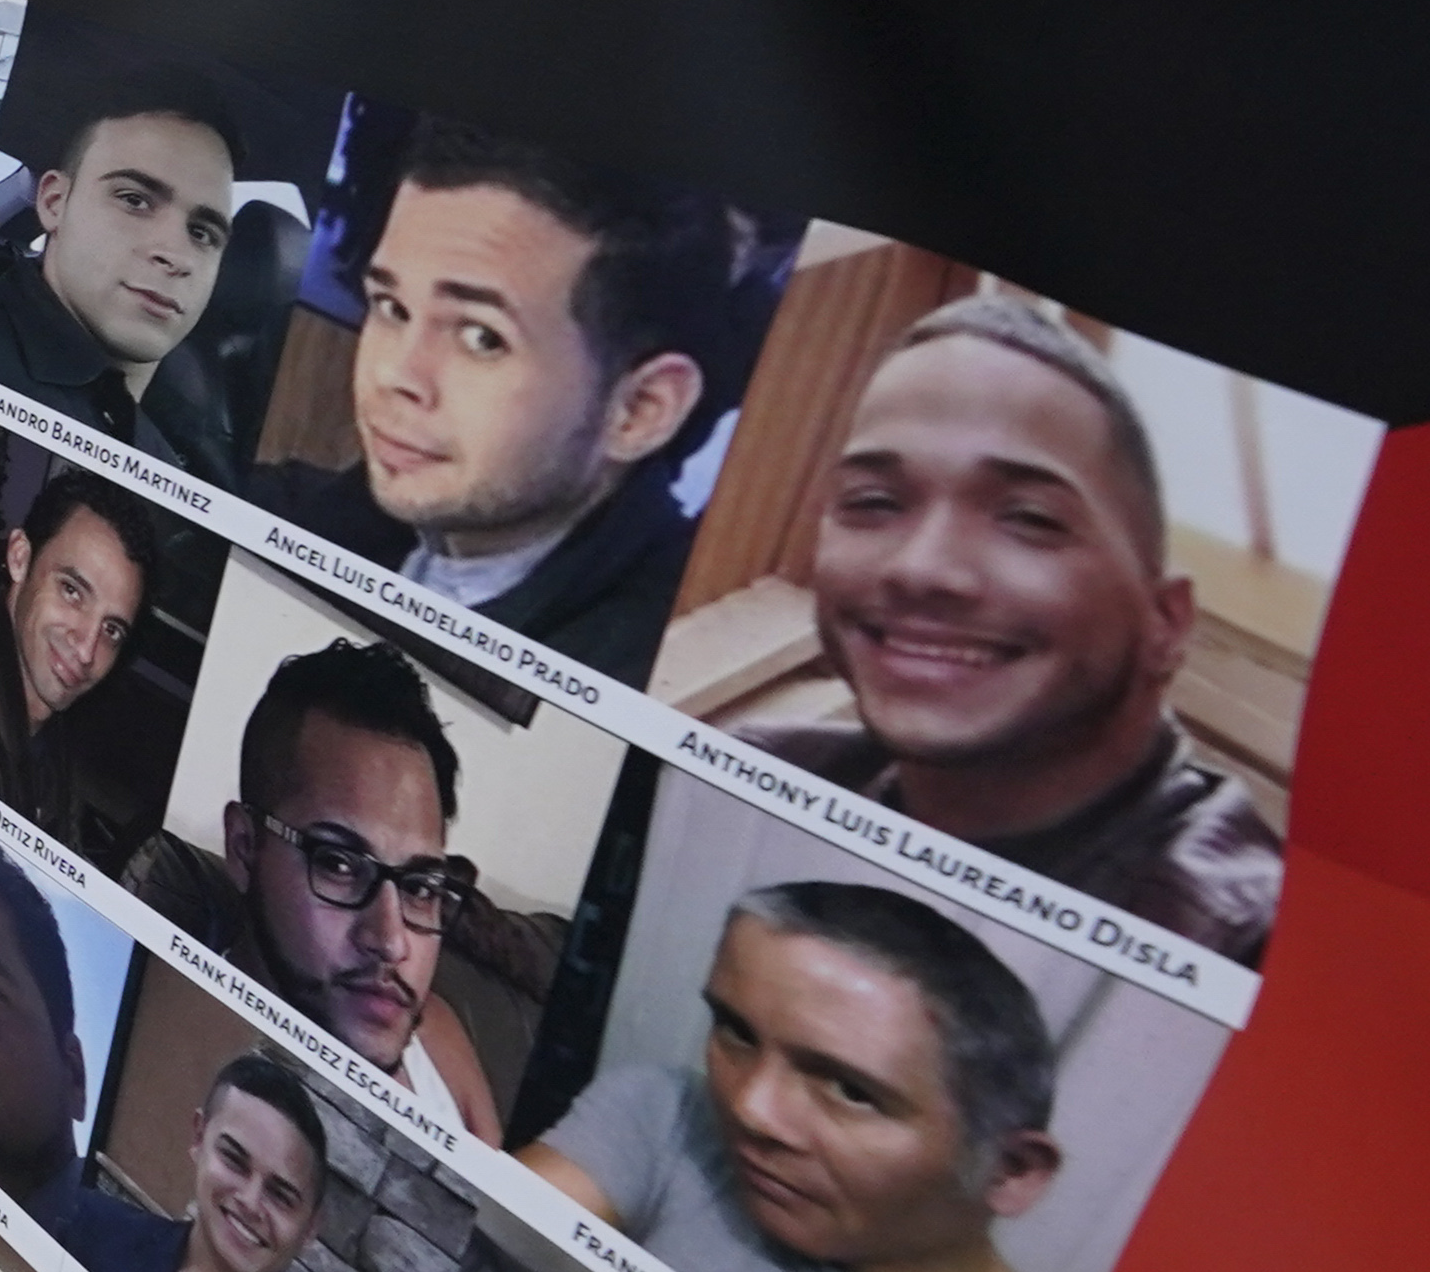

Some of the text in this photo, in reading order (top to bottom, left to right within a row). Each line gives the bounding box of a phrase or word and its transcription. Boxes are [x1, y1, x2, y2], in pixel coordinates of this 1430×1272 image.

[52, 420, 119, 469] BARRIOS
[122, 456, 212, 515] MARTINEZ
[264, 525, 601, 706] ANGEL LUIS CANDELARIO PRADO
[33, 837, 86, 888] RIVERA
[677, 730, 1202, 987] ANTHONY LUIS LAUREANO DISLA
[169, 934, 459, 1153] FRANK HERNANDEZ ESCALANTE
